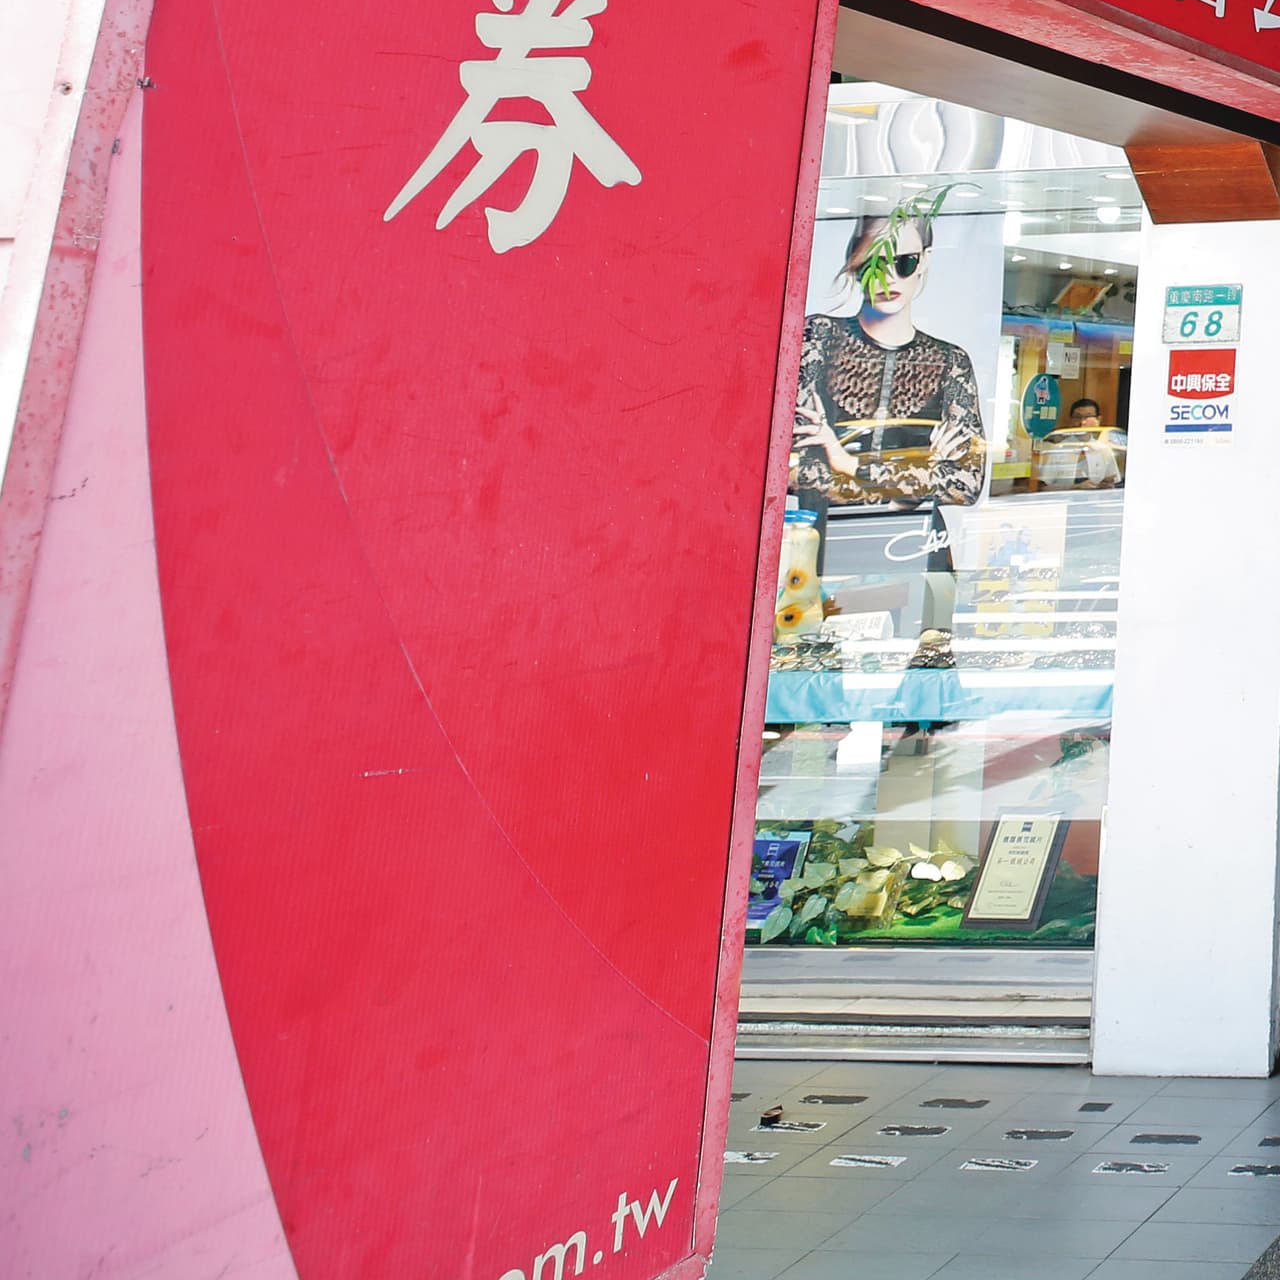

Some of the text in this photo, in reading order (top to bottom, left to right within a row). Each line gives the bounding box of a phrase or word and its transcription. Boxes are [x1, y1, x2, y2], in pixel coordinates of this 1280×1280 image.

[1180, 310, 1223, 337] 68
[1171, 374, 1231, 393] 中興保全
[1170, 404, 1229, 420] SECOM
